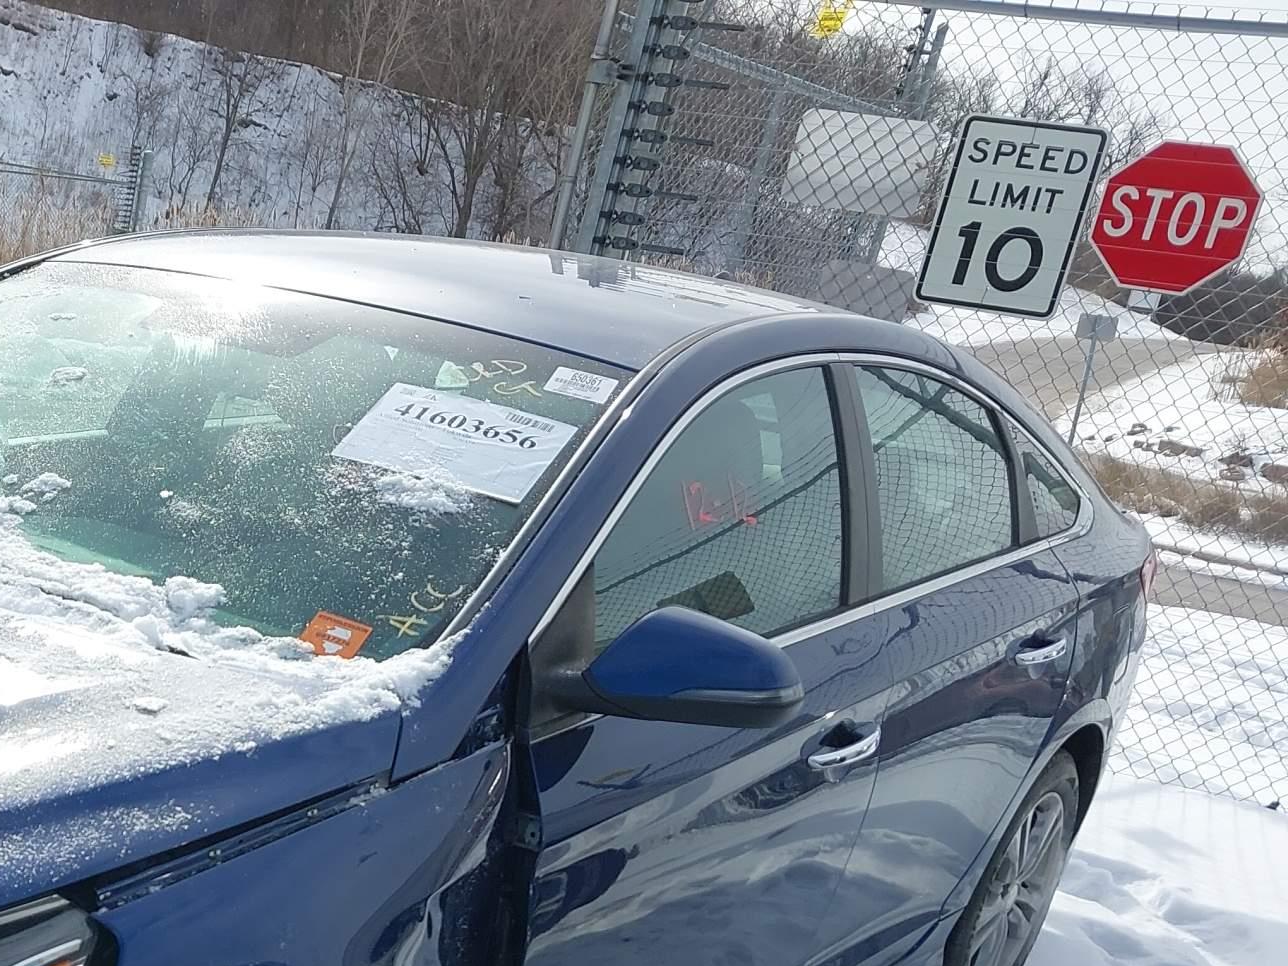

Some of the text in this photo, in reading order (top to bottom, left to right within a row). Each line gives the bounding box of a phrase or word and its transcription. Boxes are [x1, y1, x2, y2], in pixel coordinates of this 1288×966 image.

[967, 137, 1089, 175] SPEED
[967, 179, 1064, 214] LIMIT
[1103, 185, 1248, 249] STOP
[952, 221, 1044, 292] 10
[570, 372, 602, 387] 650361
[393, 403, 544, 449] 41603656
